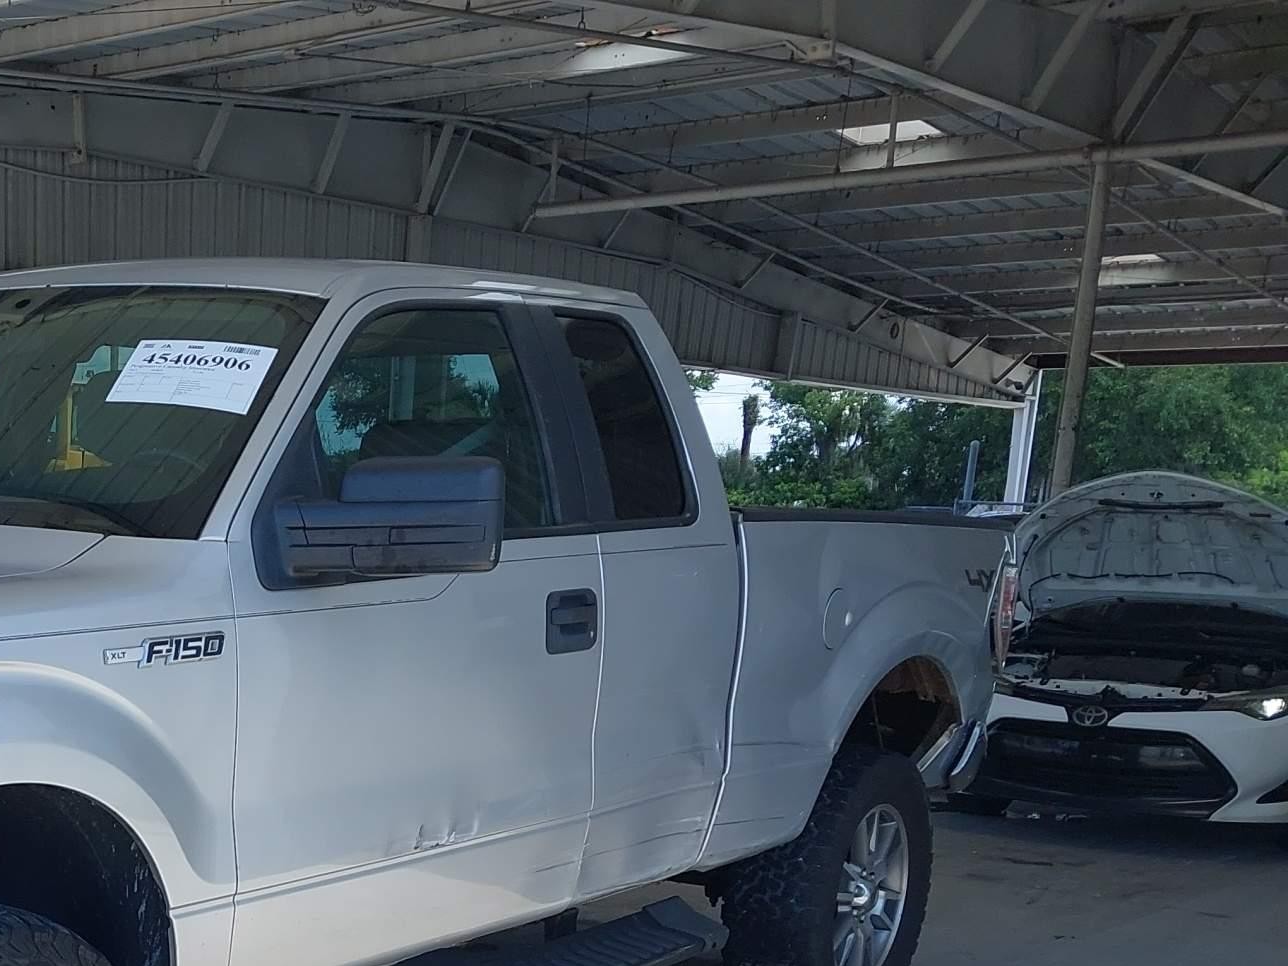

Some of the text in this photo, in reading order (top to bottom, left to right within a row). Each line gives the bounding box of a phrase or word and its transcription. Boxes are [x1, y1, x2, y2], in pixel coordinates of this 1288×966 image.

[142, 351, 252, 372] 45406906
[110, 651, 127, 660] XLT
[144, 632, 225, 665] F-150
